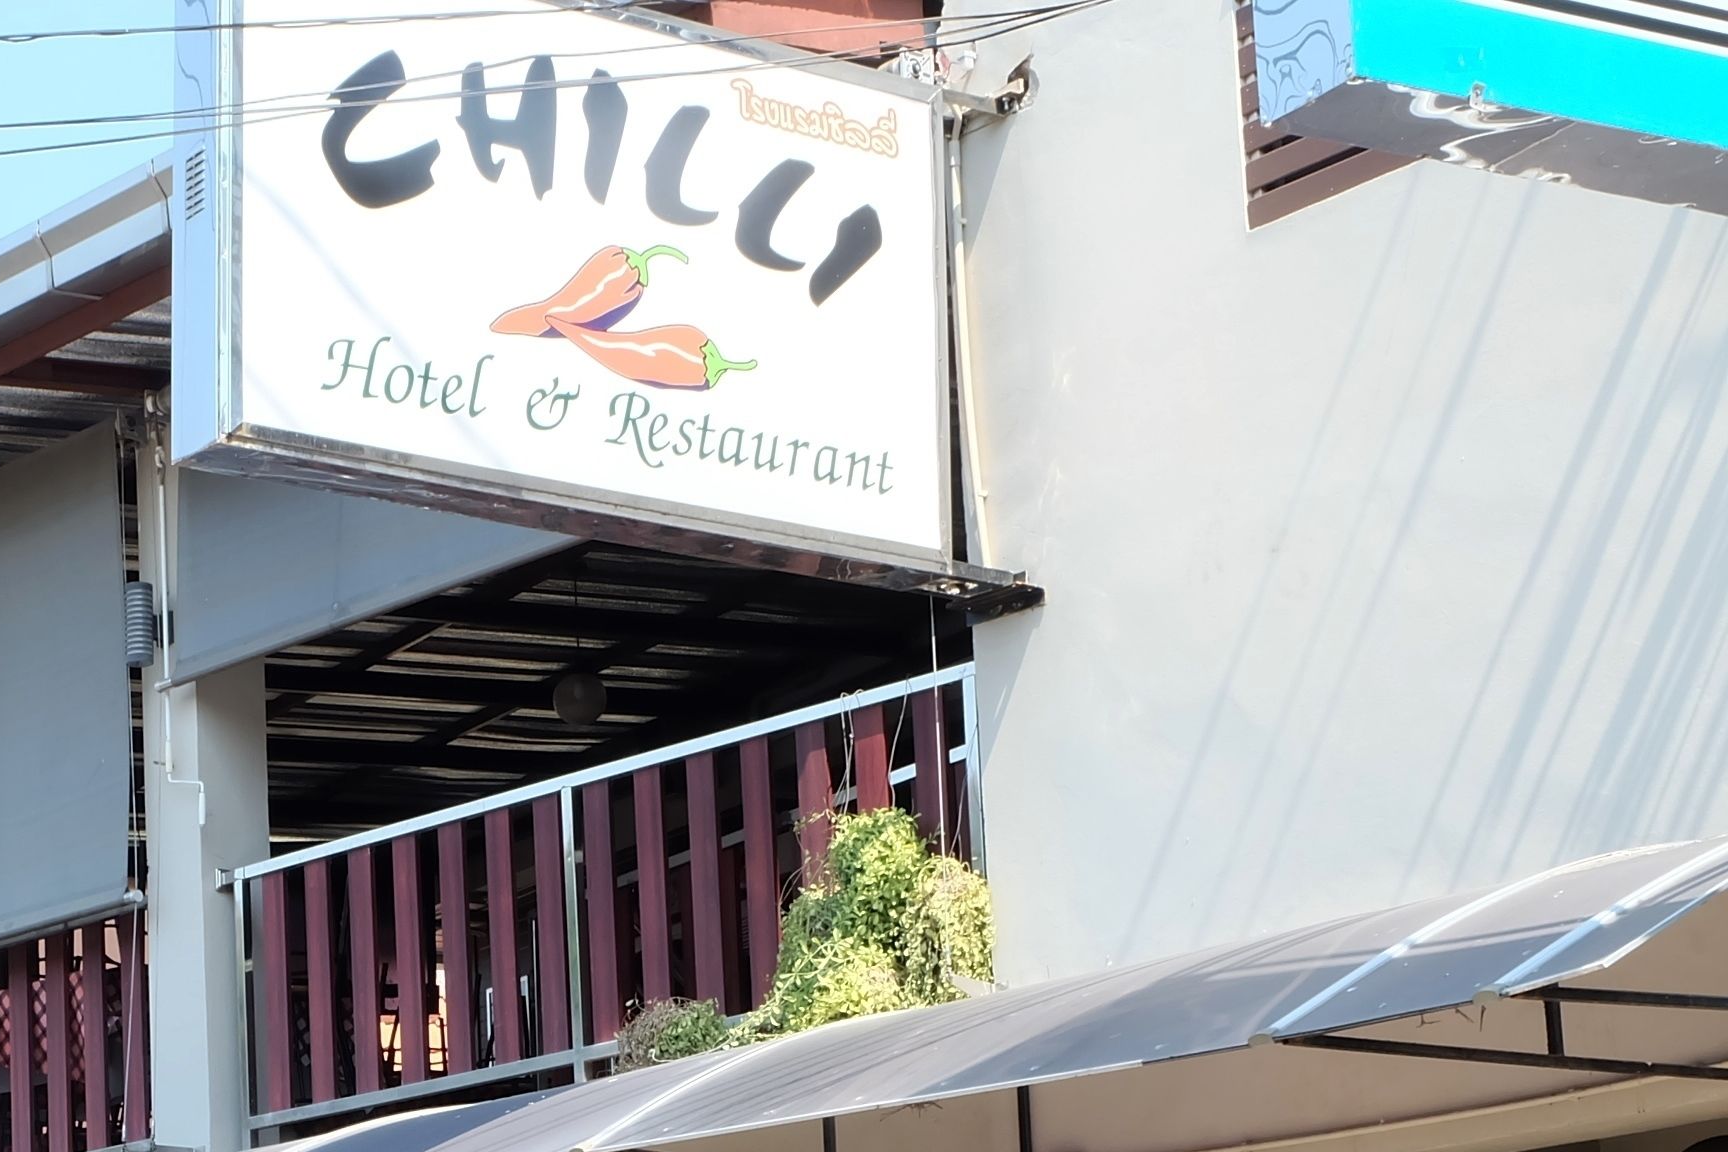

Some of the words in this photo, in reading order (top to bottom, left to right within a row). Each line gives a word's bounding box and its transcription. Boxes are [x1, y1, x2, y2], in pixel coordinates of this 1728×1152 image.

[322, 48, 883, 307] CHILLI
[321, 336, 494, 418] Hotel
[526, 376, 581, 431] &
[604, 391, 894, 495] Restaurant
